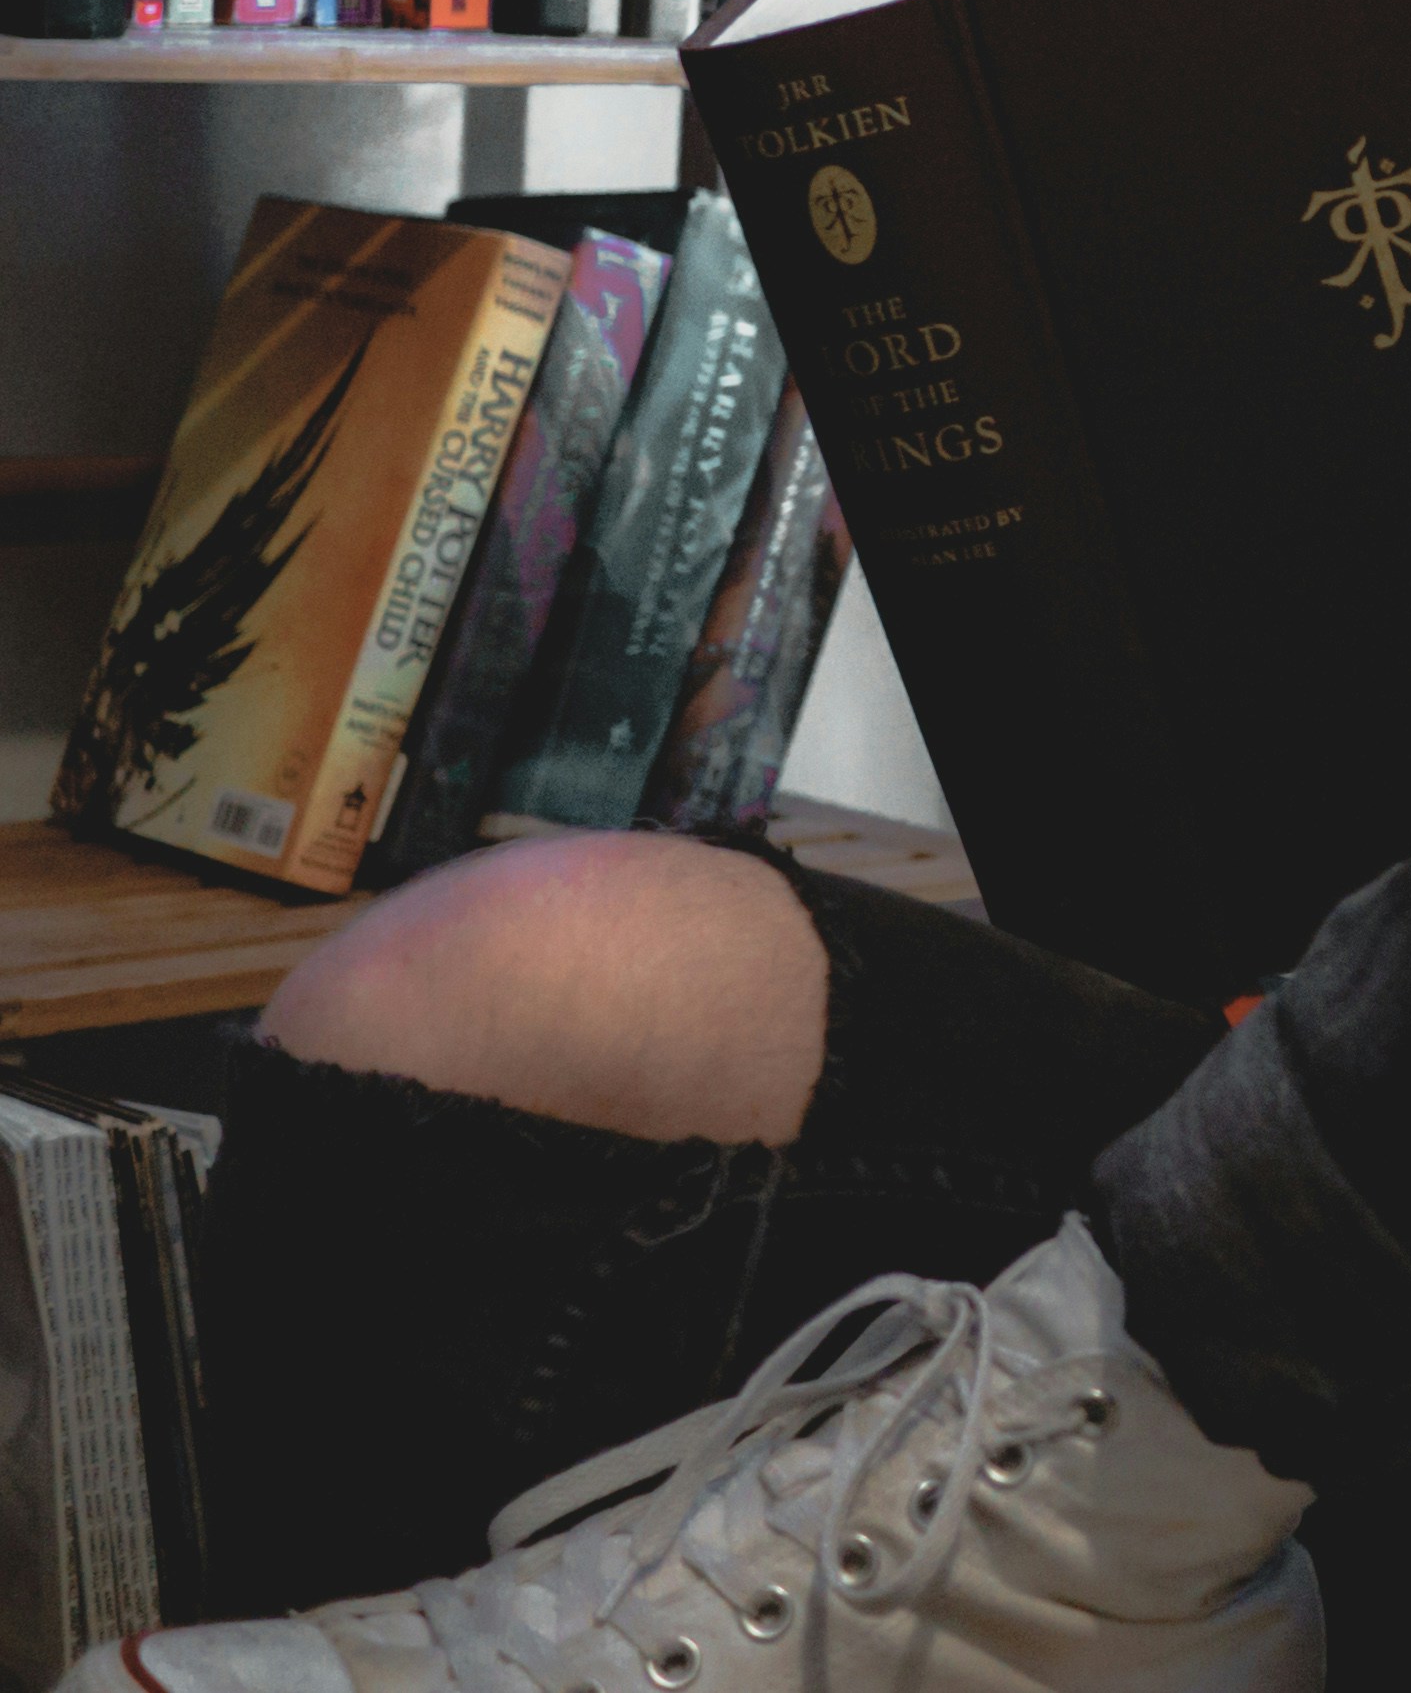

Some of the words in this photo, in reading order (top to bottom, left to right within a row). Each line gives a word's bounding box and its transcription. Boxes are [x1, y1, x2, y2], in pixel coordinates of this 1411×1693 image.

[777, 74, 832, 111] JRR
[738, 96, 912, 160] TOLKIEN
[843, 296, 906, 330] THE
[820, 322, 963, 382] LORD
[457, 348, 533, 499] HARRY
[698, 319, 757, 486] HARRY
[893, 380, 960, 417] THE
[850, 415, 1005, 475] RINGS
[411, 428, 467, 548] CURSED
[880, 514, 991, 541] STRATED
[995, 505, 1024, 528] BY
[376, 552, 426, 650] CHILD
[396, 504, 478, 672] POTTER
